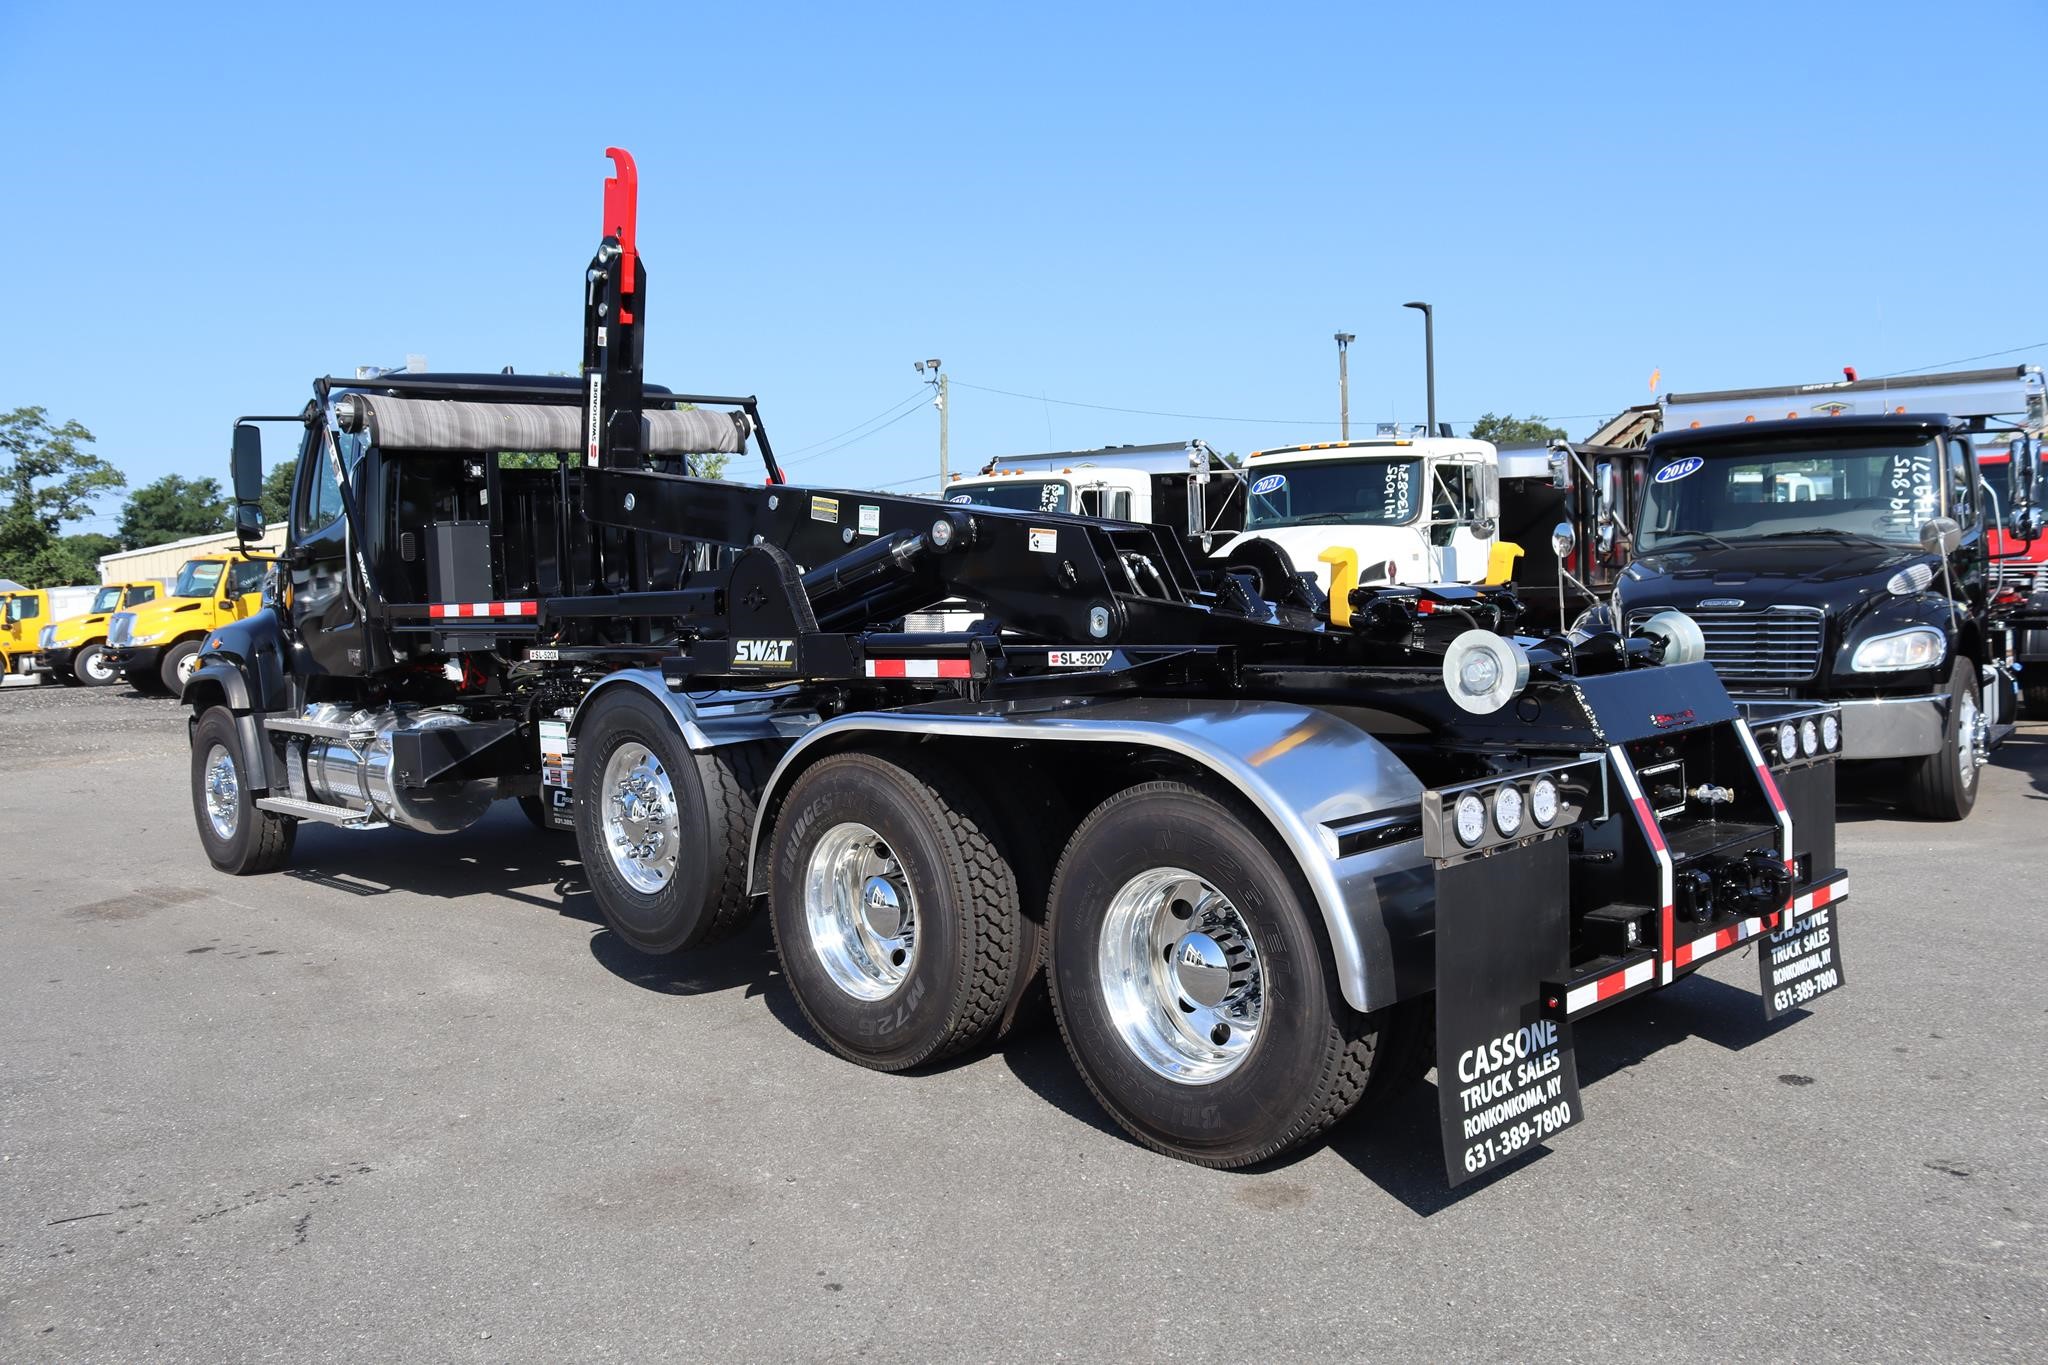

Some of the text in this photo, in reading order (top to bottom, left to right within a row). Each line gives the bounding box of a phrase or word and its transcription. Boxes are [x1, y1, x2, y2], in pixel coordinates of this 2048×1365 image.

[735, 640, 793, 661] SWAT
[1771, 927, 1830, 965] TRUCK SALES
[1774, 968, 1838, 1011] 631-389-7800
[1458, 1020, 1558, 1083] CASSONE
[1460, 1049, 1560, 1112] TRUCK SALES
[1463, 1075, 1562, 1139] RONKONKOMA, NY
[1465, 1101, 1571, 1173] 631-389-7800
